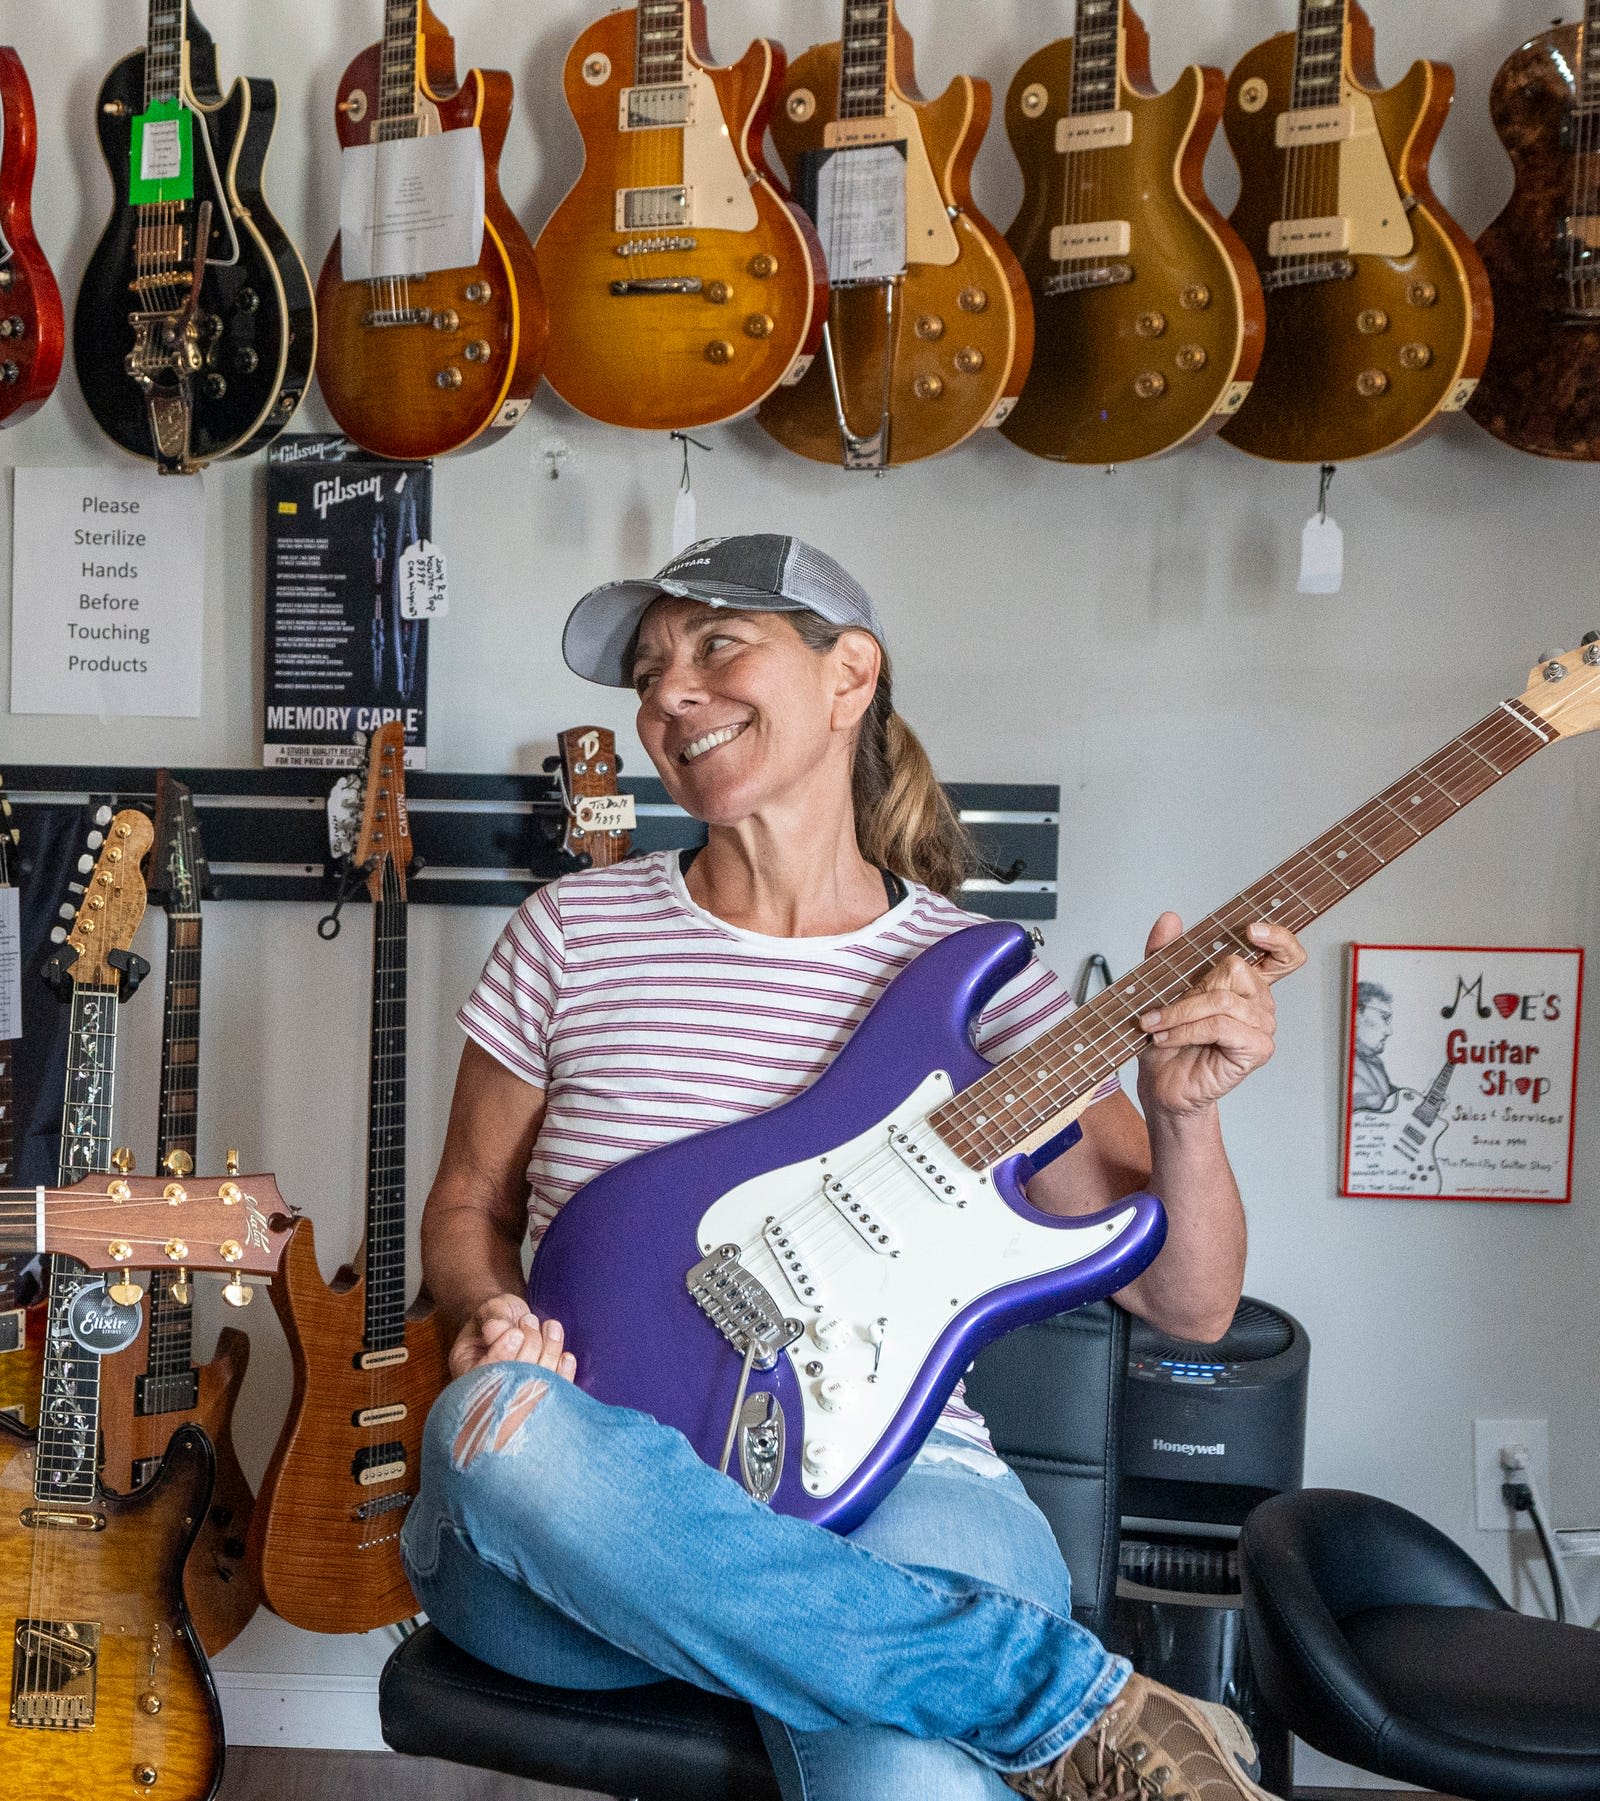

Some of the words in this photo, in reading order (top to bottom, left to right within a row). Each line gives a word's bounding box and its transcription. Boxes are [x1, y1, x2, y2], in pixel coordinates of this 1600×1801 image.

[279, 440, 325, 463] Gibson
[82, 496, 140, 514] Please
[312, 474, 384, 520] Gibson
[74, 529, 147, 546] Sterilize
[82, 562, 138, 578] Hands
[667, 558, 711, 574] GUITARS
[79, 593, 139, 611] Before
[67, 623, 150, 644] Touching
[68, 656, 148, 673] Products
[267, 706, 351, 730] MEMORY
[275, 757, 289, 765] FOR
[290, 757, 302, 765] THE
[304, 757, 324, 765] PRICE
[326, 757, 335, 765] OF
[336, 757, 346, 765] AN
[280, 747, 286, 755] A
[286, 747, 310, 756] STUDIO
[312, 748, 339, 756] QUALITY
[397, 792, 409, 837] CARVIN
[1441, 972, 1562, 1021] MOE'S
[1446, 1029, 1540, 1065] Guitar
[1480, 1070, 1551, 1103] Shop
[1452, 1105, 1487, 1122] Sales
[1502, 1107, 1564, 1124] Services
[80, 1310, 128, 1335] Elixir
[1152, 1438, 1226, 1456] Honeywell
